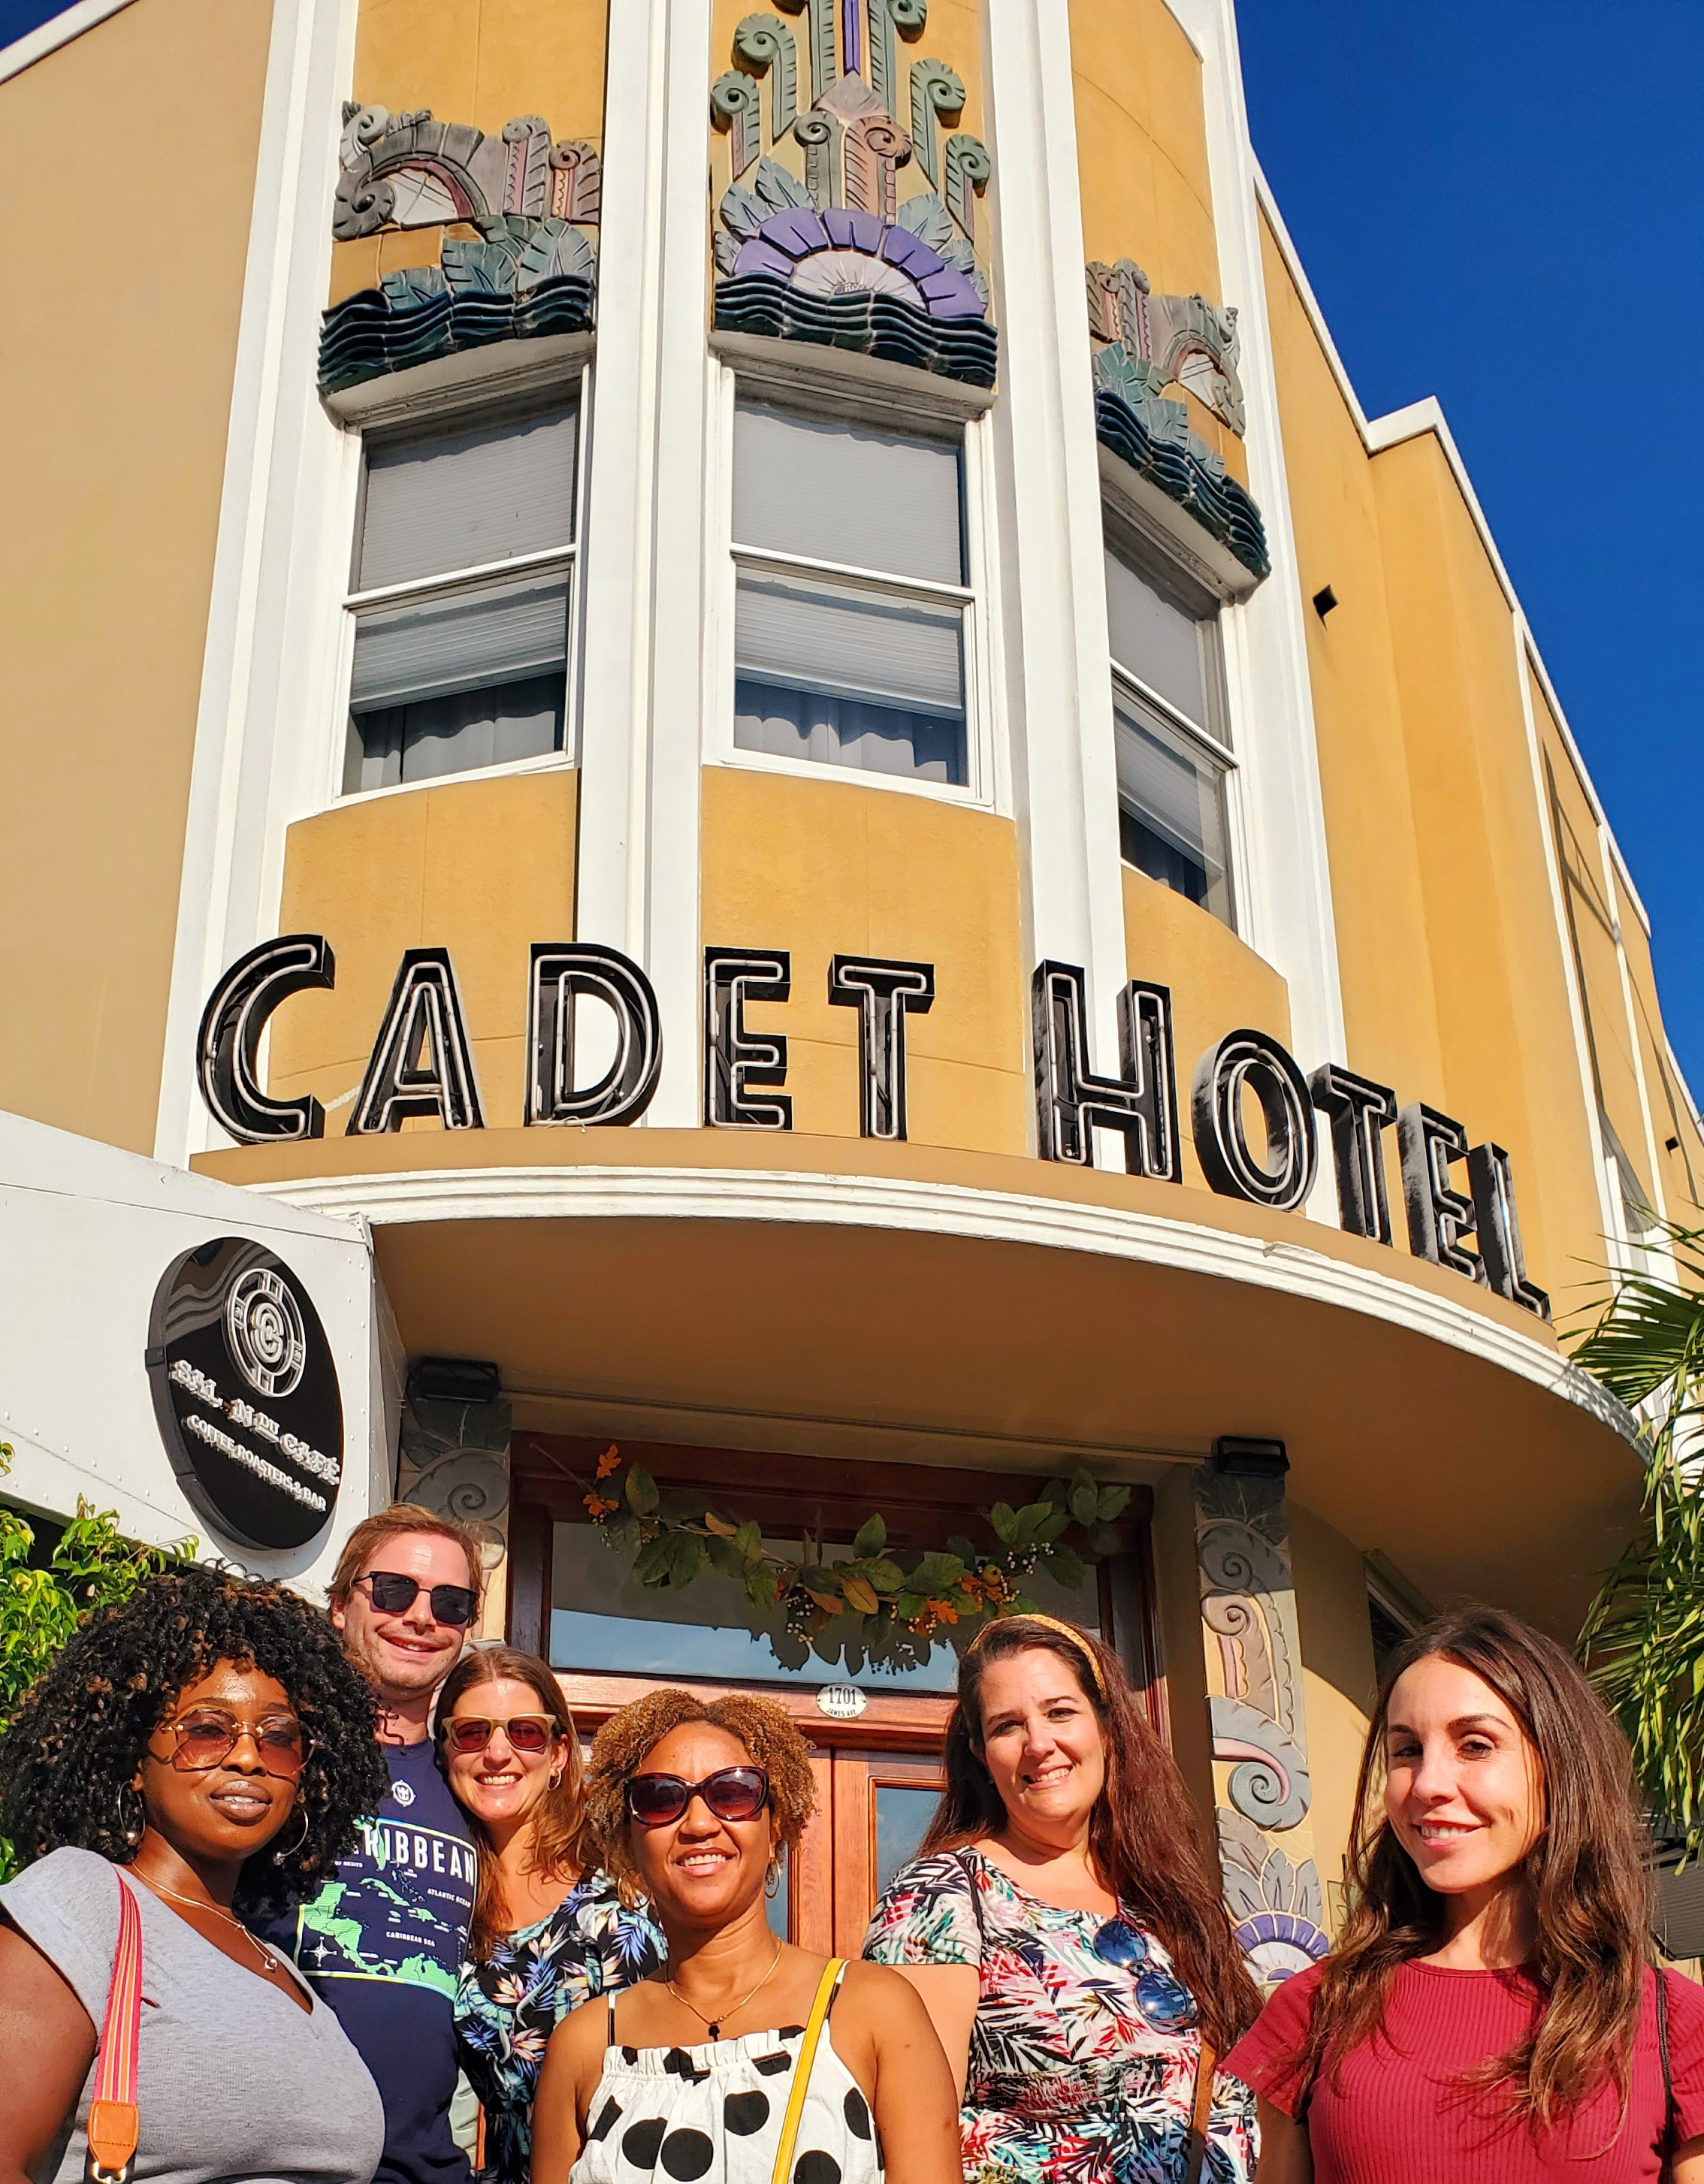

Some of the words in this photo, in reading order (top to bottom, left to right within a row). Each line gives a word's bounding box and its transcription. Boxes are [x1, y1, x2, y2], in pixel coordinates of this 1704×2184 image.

[197, 934, 936, 1145] CADET
[1031, 959, 1553, 1326] HOTEL
[251, 1412, 280, 1438] DU
[185, 1414, 236, 1456] COFFEE
[231, 1443, 293, 1488] ROASTERS
[299, 1486, 327, 1512] BAR
[828, 1687, 857, 1705] 1701
[826, 1708, 845, 1717] JAMES
[847, 1708, 857, 1717] AVE
[353, 1823, 473, 1886] RIBBEAN
[427, 1888, 455, 1902] ATLANTIC
[455, 1896, 472, 1908] OCEAN
[385, 1931, 422, 1944] CARIBBEAN
